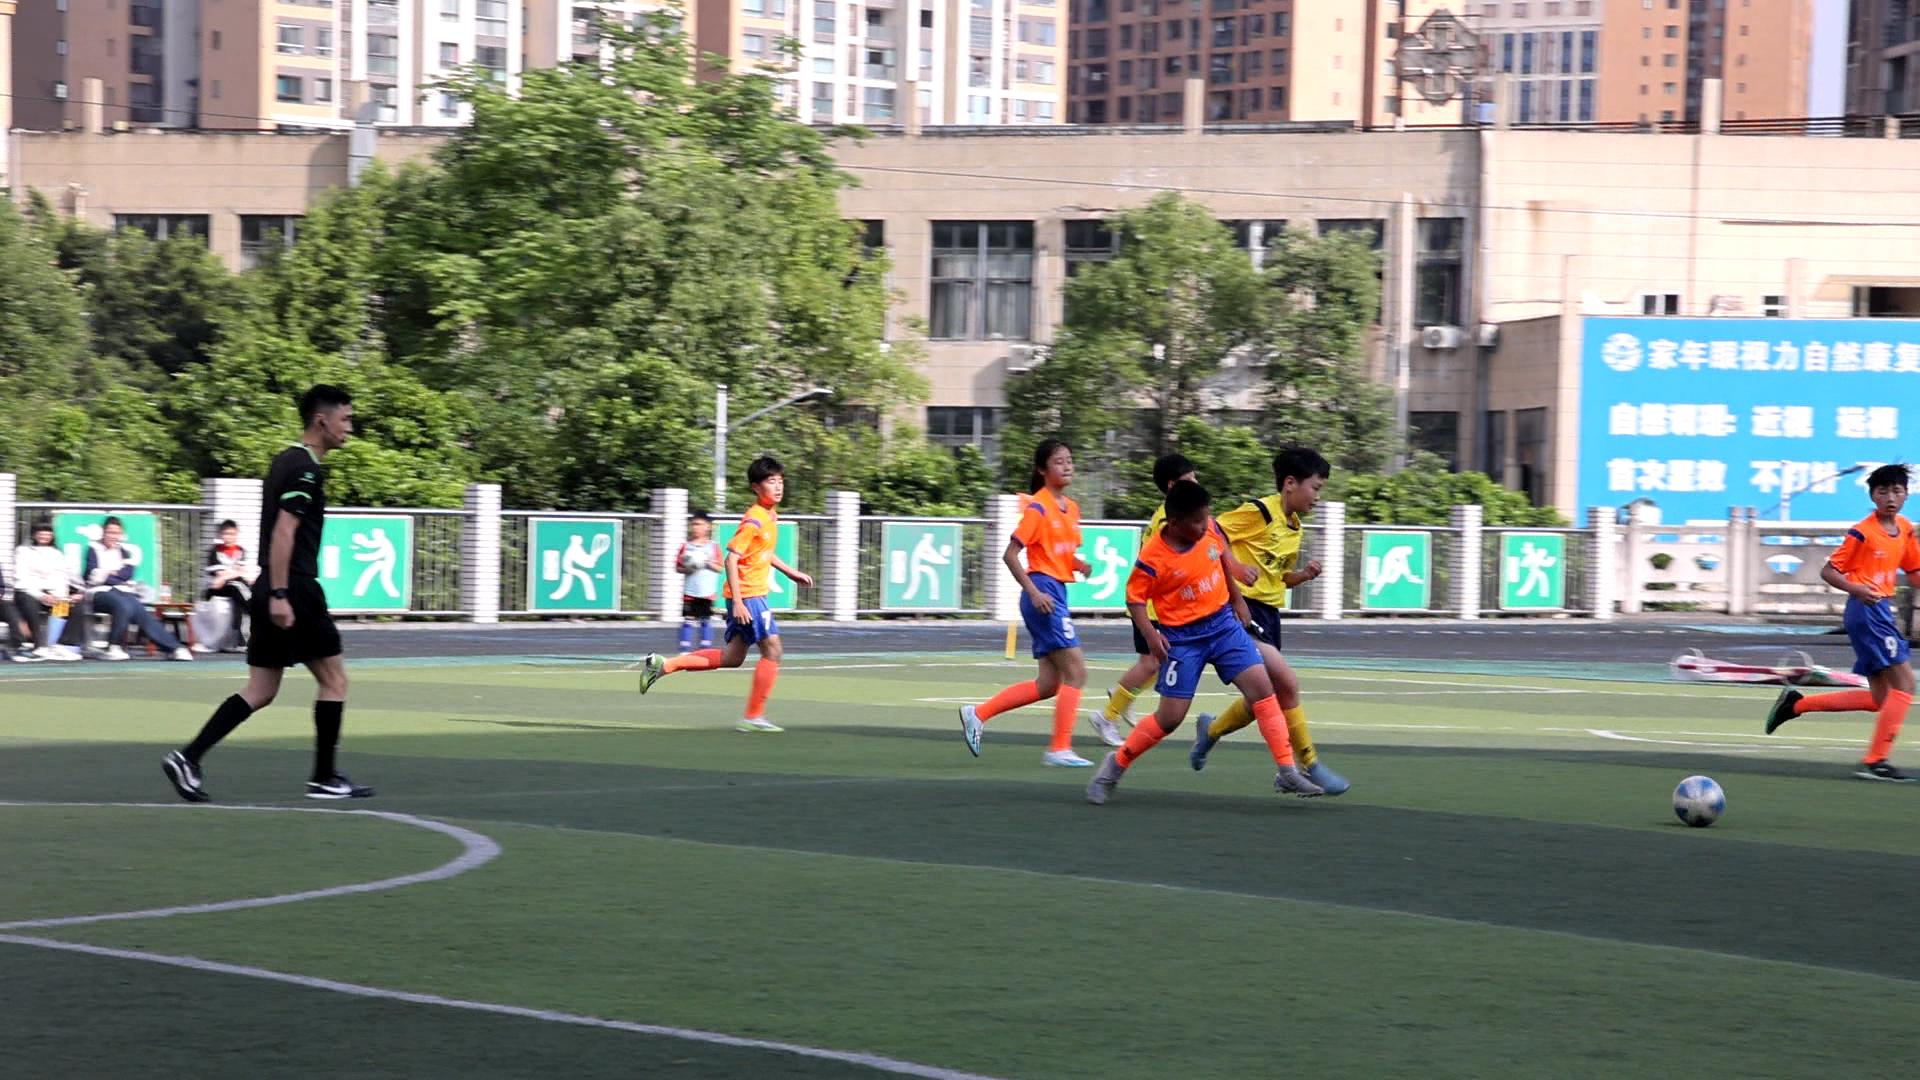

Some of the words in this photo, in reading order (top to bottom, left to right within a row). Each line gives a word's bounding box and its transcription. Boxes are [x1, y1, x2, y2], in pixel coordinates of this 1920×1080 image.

[761, 610, 771, 631] 7
[1062, 617, 1075, 639] 5
[1885, 636, 1897, 658] 9
[1165, 660, 1178, 687] 6
